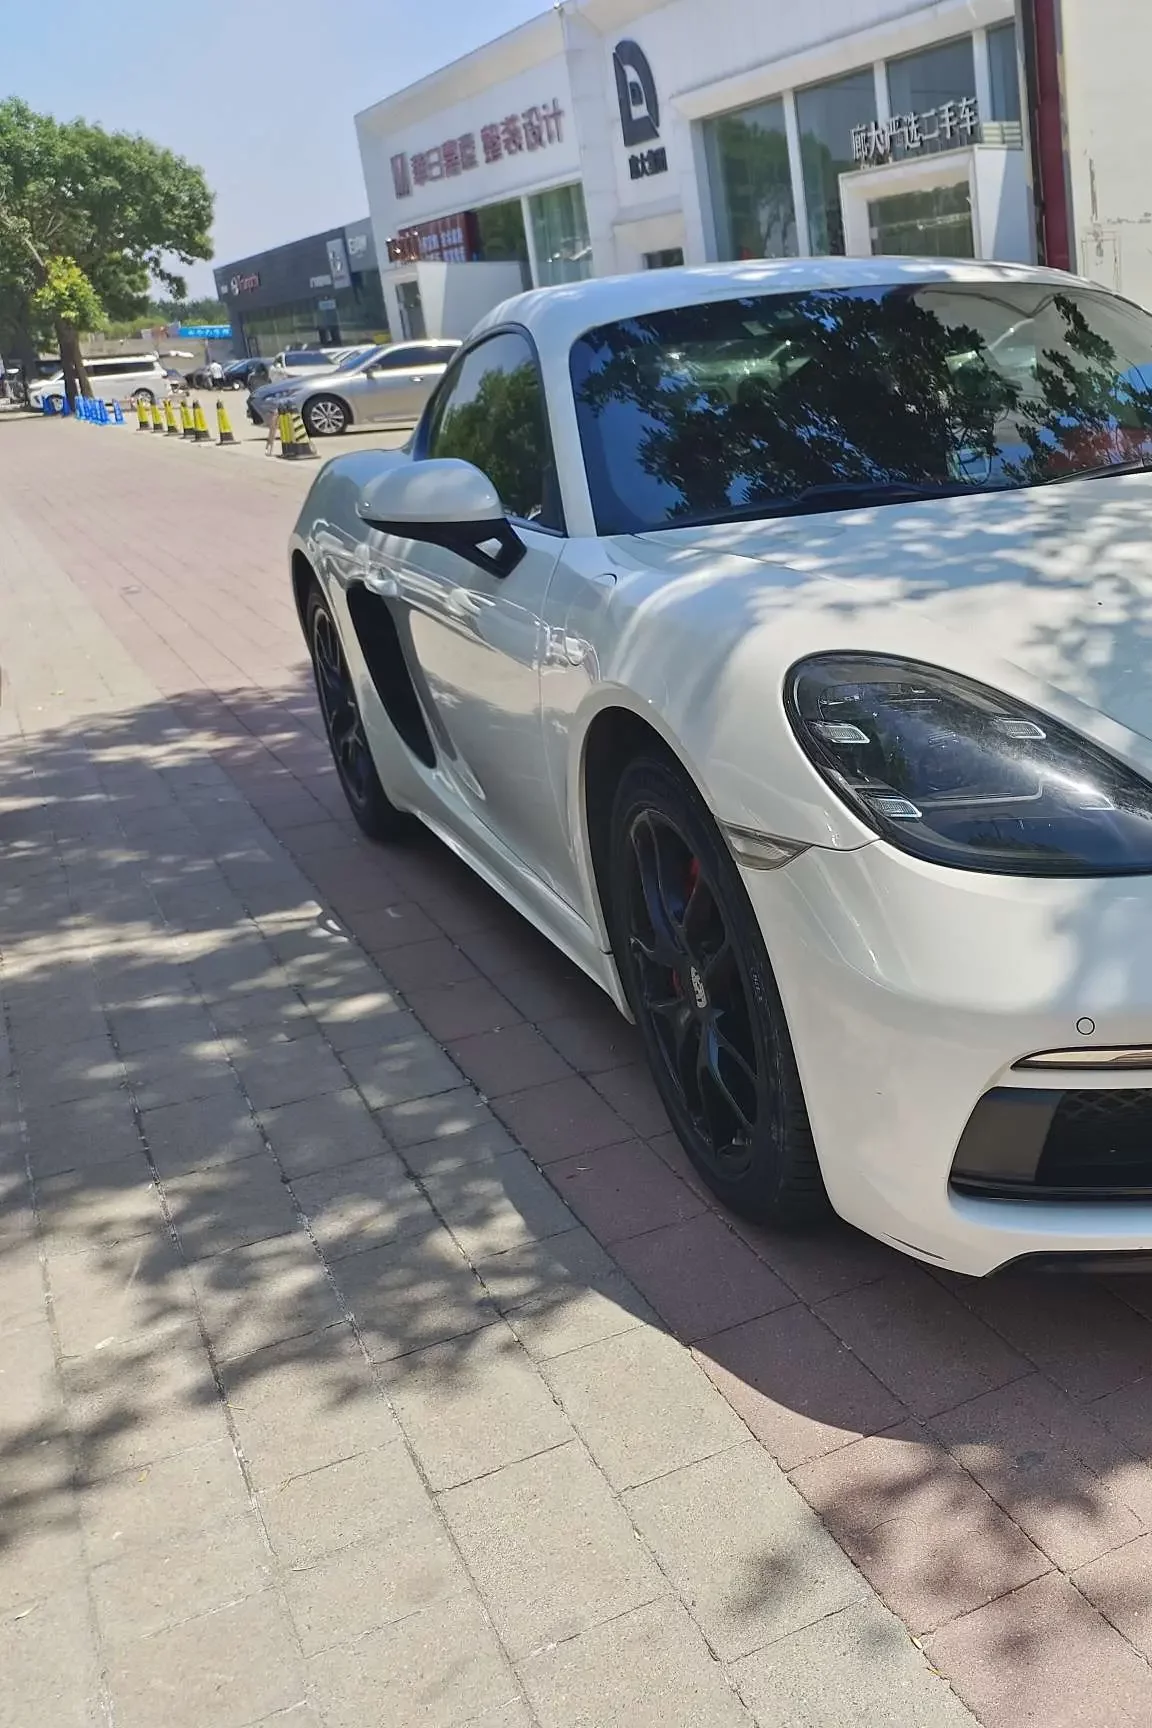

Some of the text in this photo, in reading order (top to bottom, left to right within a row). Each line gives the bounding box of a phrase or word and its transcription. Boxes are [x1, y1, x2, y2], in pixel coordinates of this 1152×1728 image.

[850, 96, 979, 161] 廊大严选二手车
